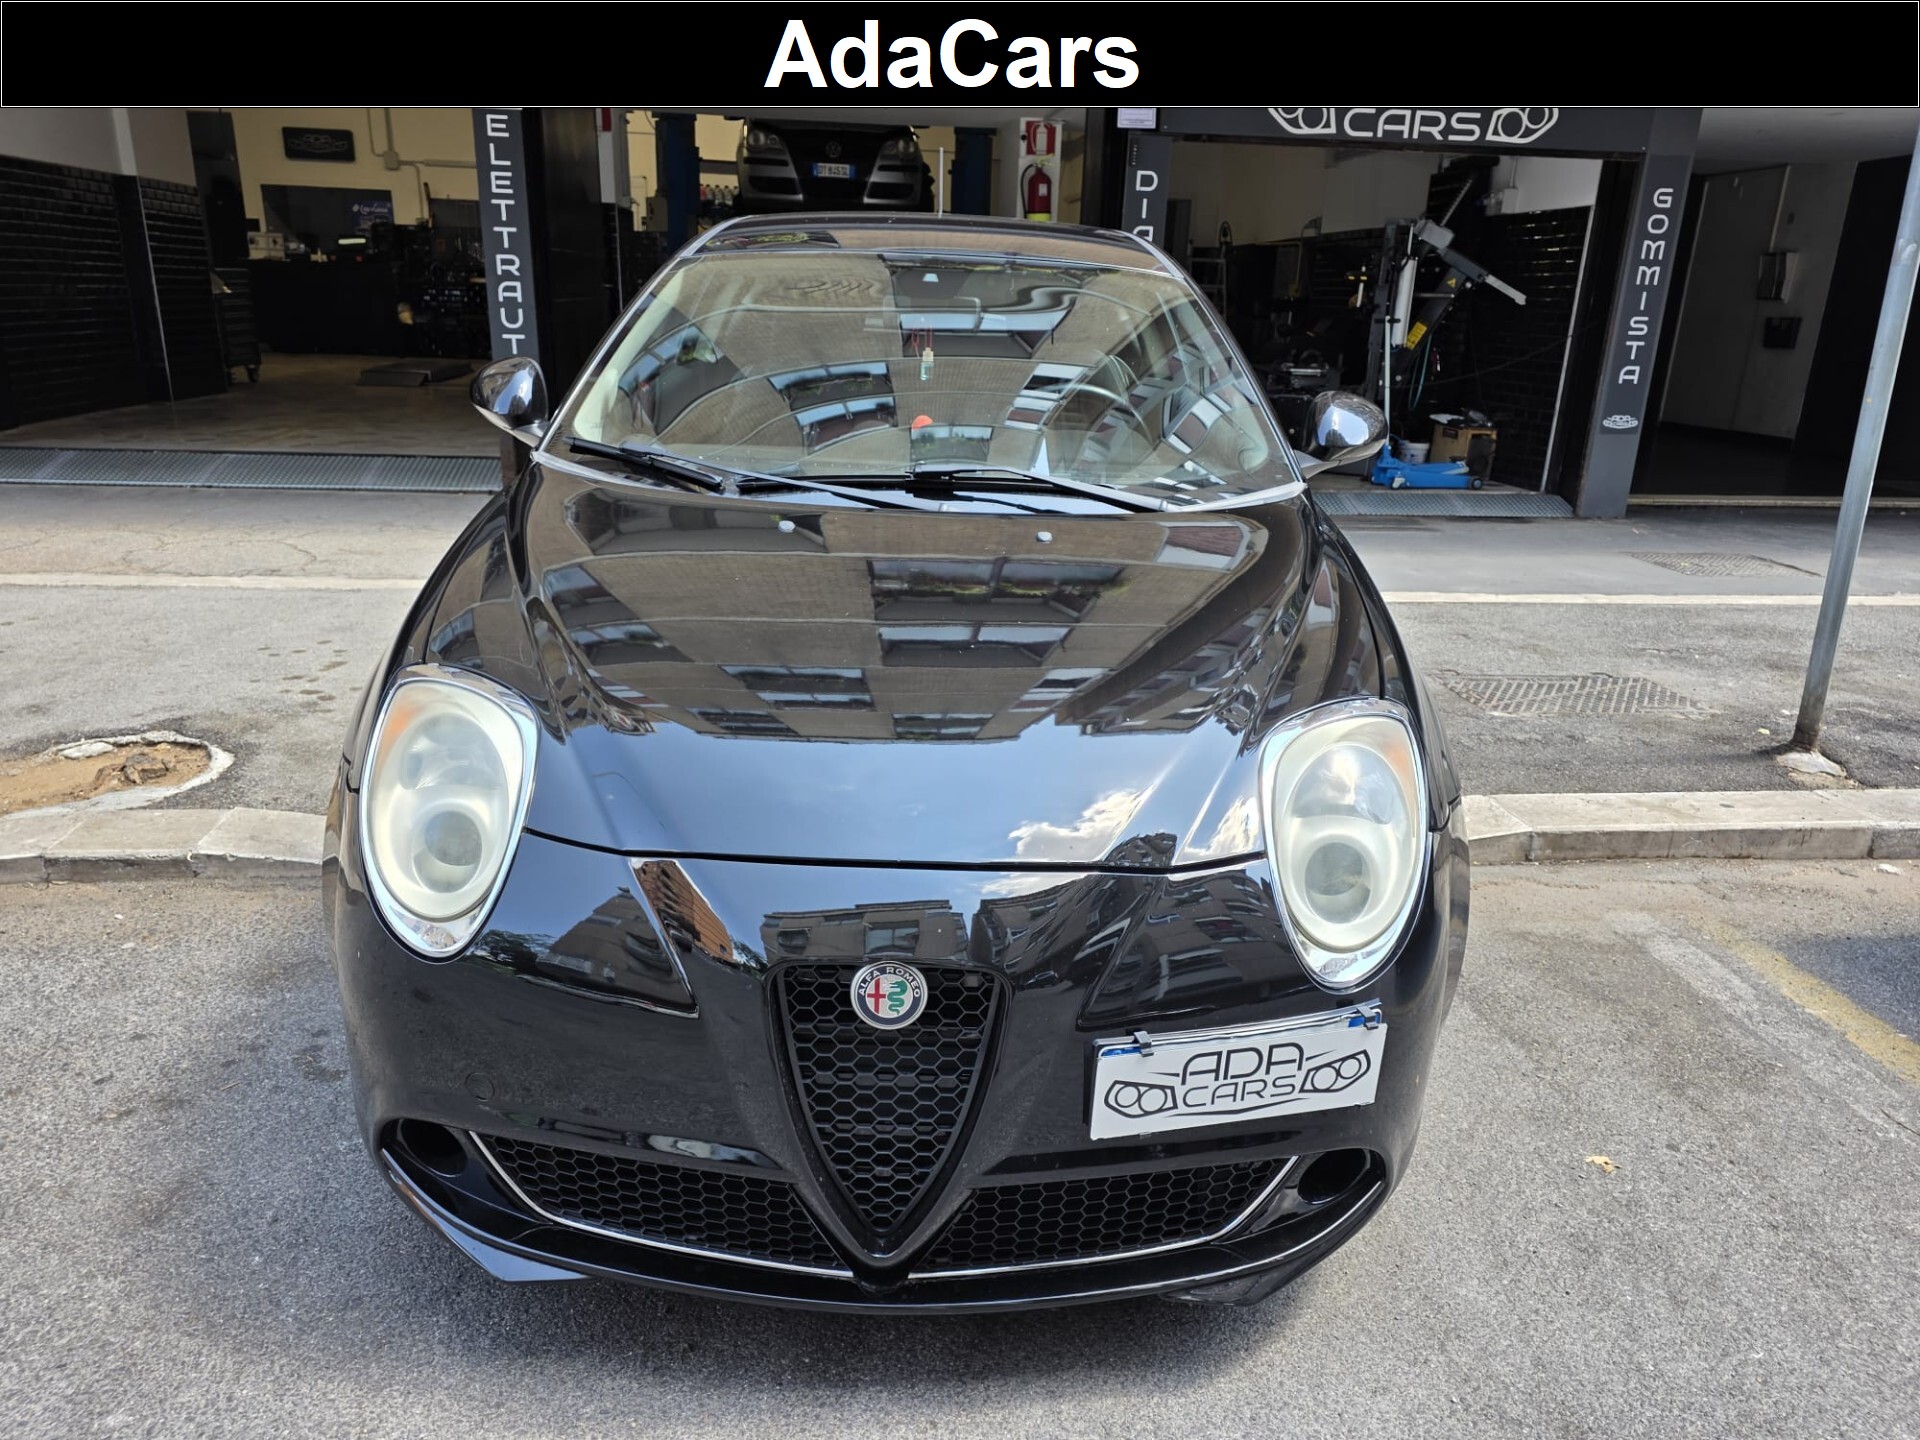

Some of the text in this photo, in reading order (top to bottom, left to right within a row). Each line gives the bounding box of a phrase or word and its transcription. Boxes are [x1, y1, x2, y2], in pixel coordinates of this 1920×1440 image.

[1343, 108, 1482, 142] CARS
[1618, 187, 1674, 385] GOMMISTA
[858, 966, 921, 998] ALFA ROMEO
[1181, 1042, 1305, 1086] ADA
[1182, 1074, 1297, 1108] CARS
